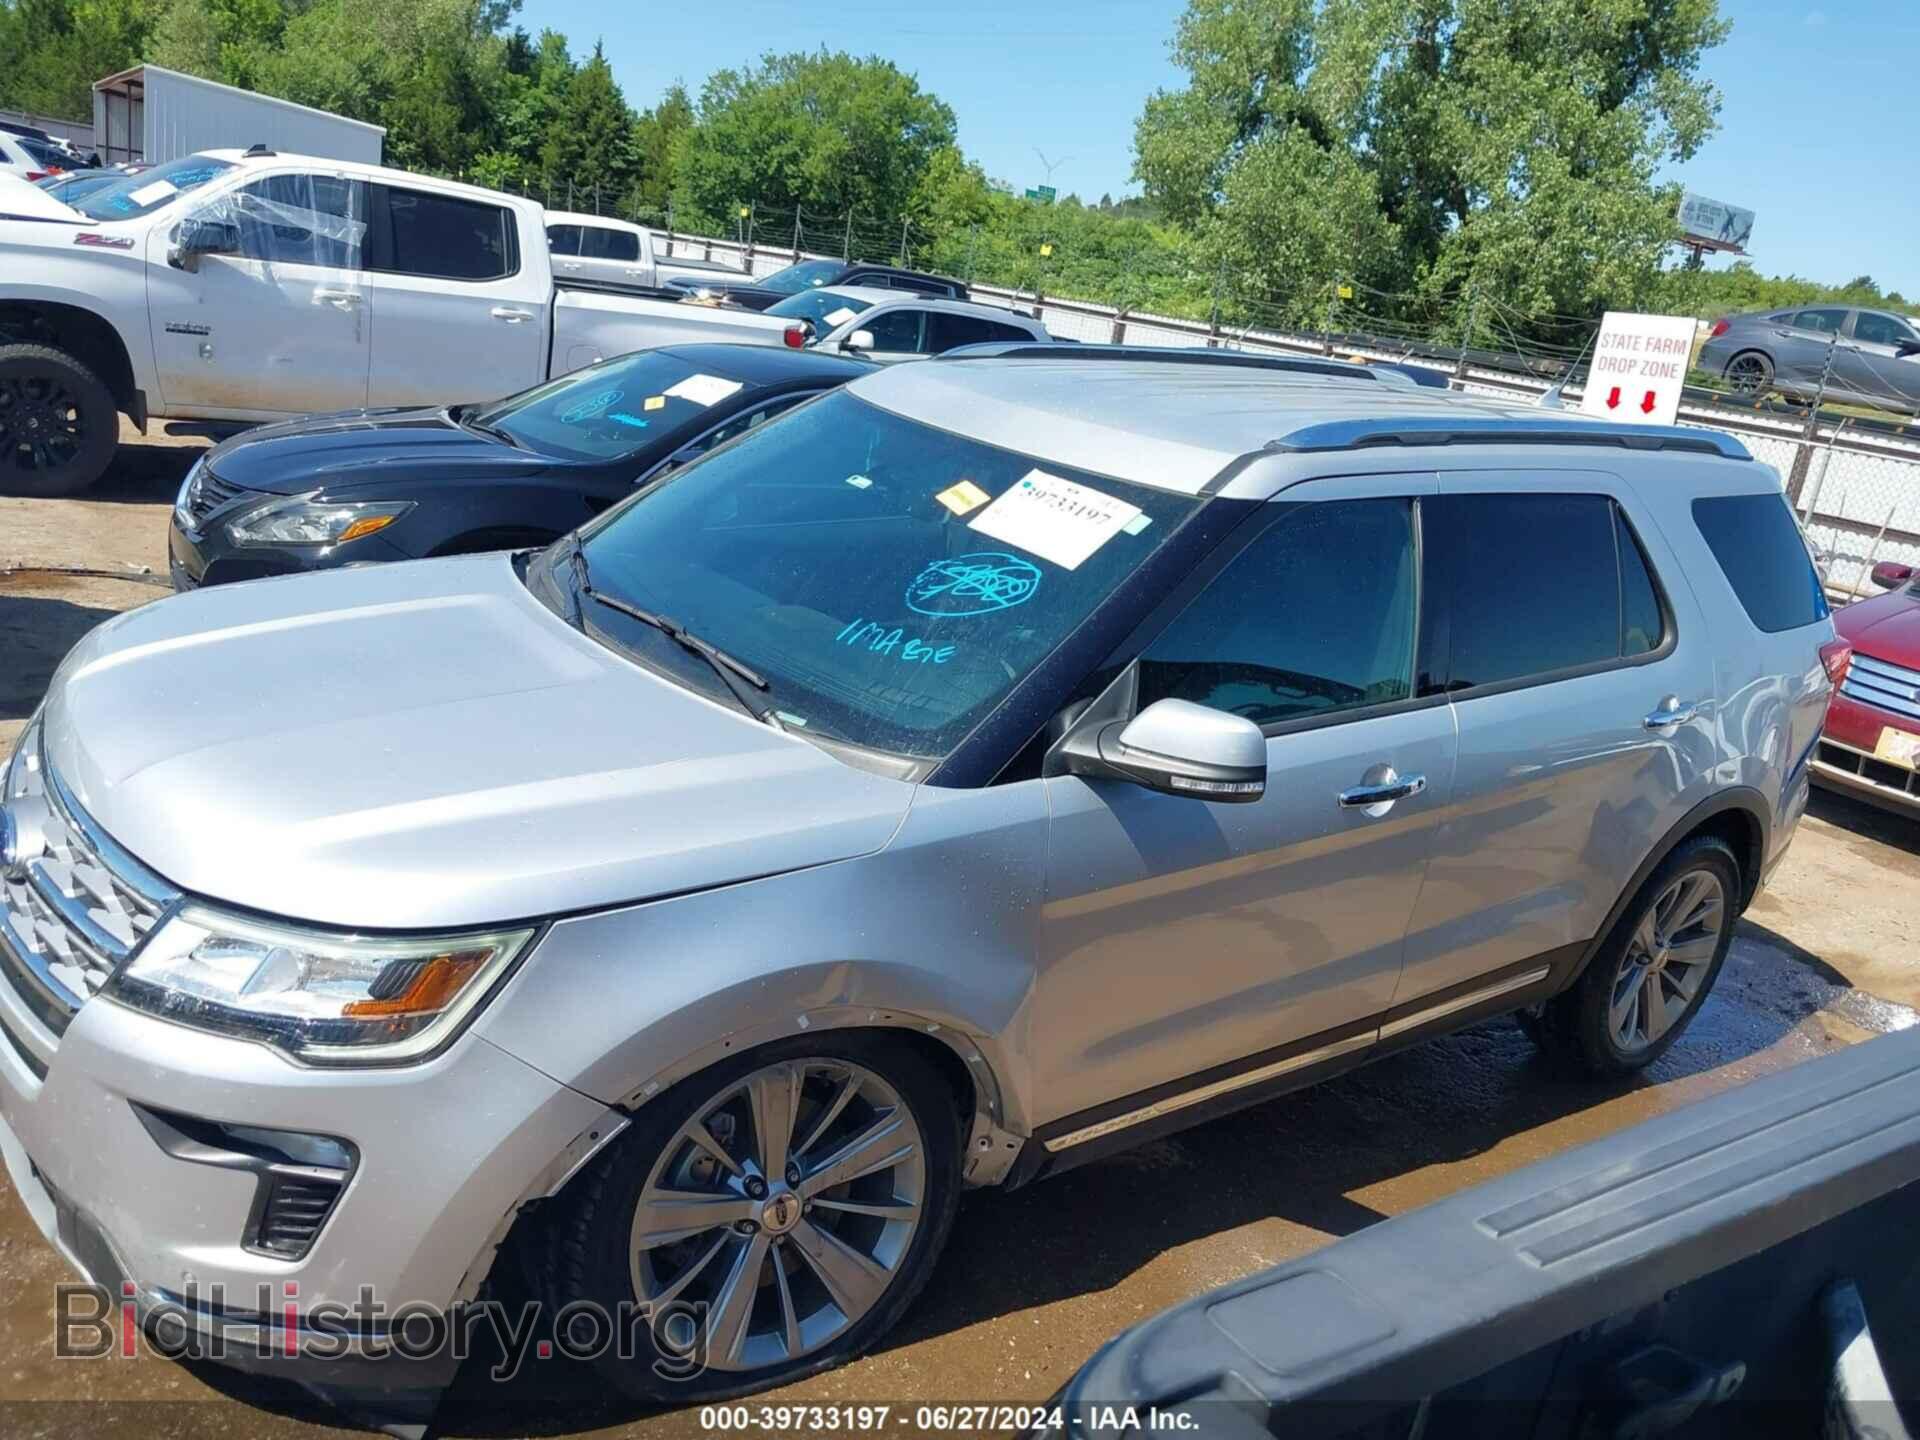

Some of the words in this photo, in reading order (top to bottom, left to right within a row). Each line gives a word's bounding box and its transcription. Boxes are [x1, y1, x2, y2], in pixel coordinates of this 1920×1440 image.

[1600, 333, 1641, 351] STATE
[1645, 336, 1687, 355] FARM
[1597, 355, 1637, 374] DROP
[1640, 360, 1680, 379] ZONE
